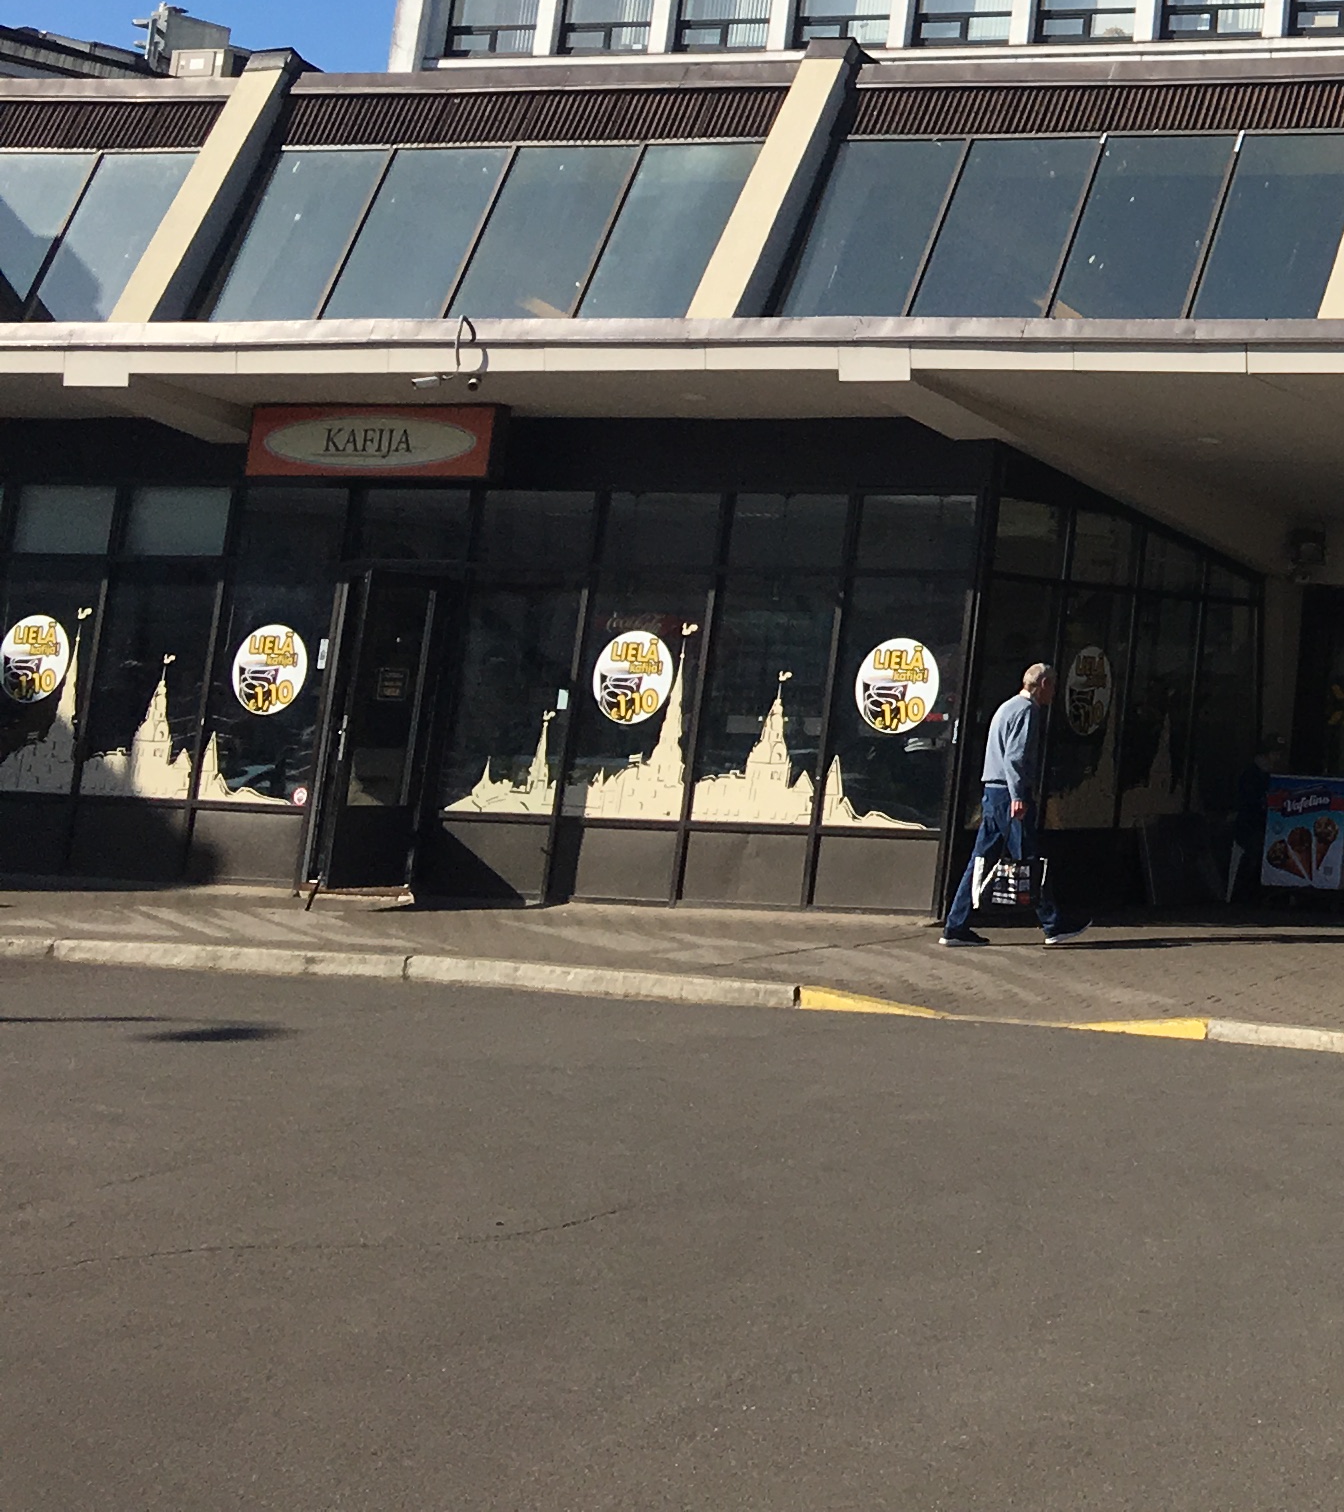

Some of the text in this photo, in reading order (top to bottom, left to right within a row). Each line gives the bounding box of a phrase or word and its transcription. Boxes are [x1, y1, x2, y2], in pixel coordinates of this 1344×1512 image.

[323, 428, 413, 459] KAFIJA
[14, 621, 57, 644] LIELĀ
[249, 631, 295, 655] LIELĀ
[611, 638, 659, 662] LIELĀ
[874, 645, 925, 670] LIELĀ
